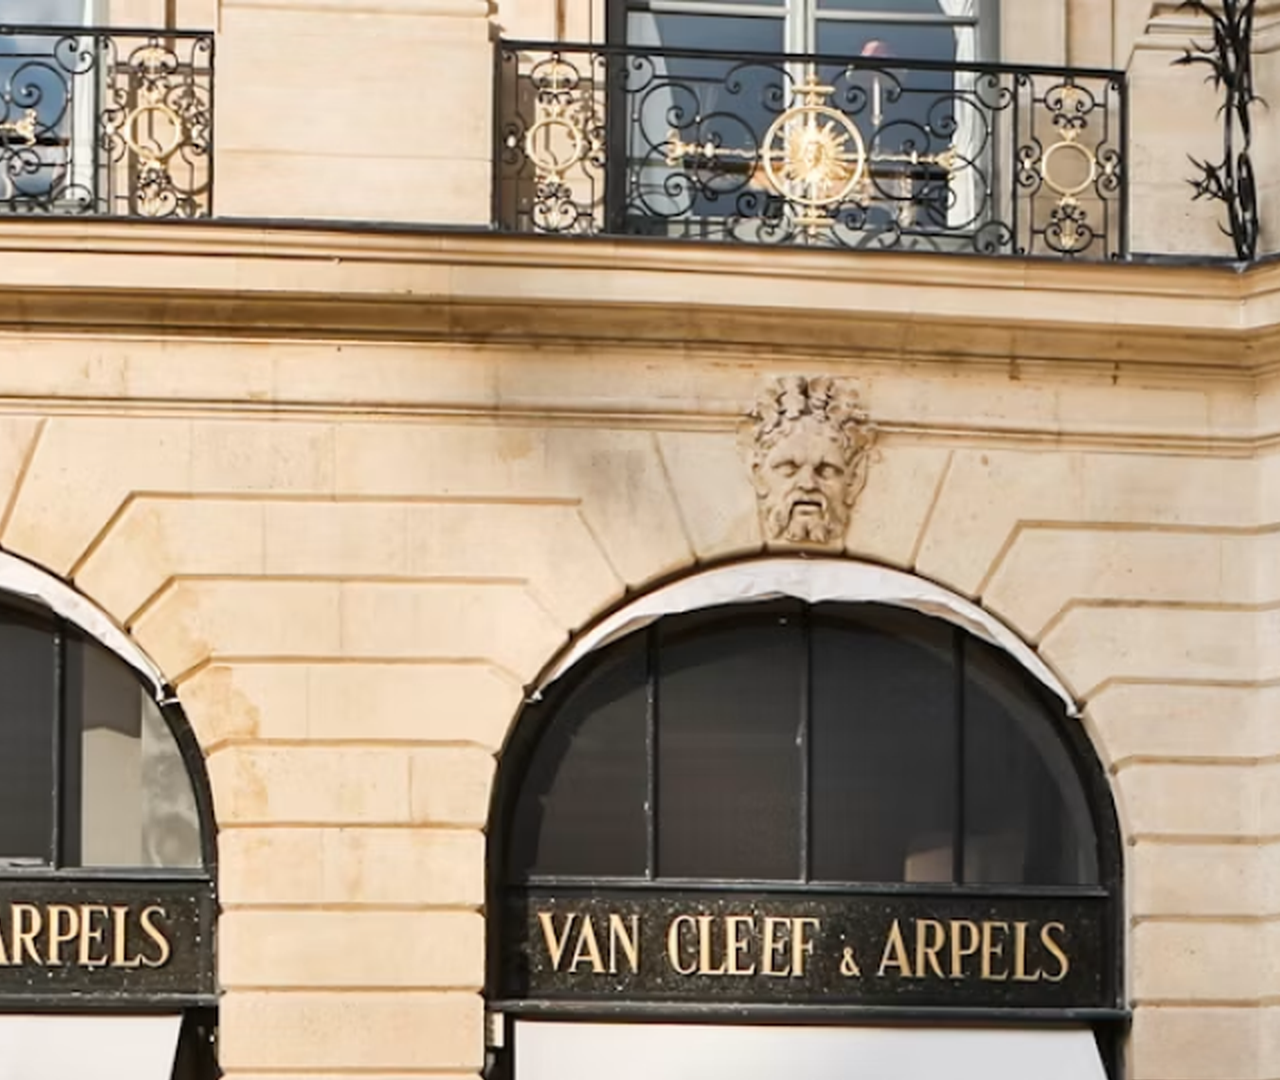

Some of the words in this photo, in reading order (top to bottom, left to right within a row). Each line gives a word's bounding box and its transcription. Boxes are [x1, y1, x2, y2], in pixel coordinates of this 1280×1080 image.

[538, 912, 639, 975] VAN
[667, 914, 819, 977] CLEEF
[840, 946, 861, 978] &
[878, 919, 1069, 982] ARPELS
